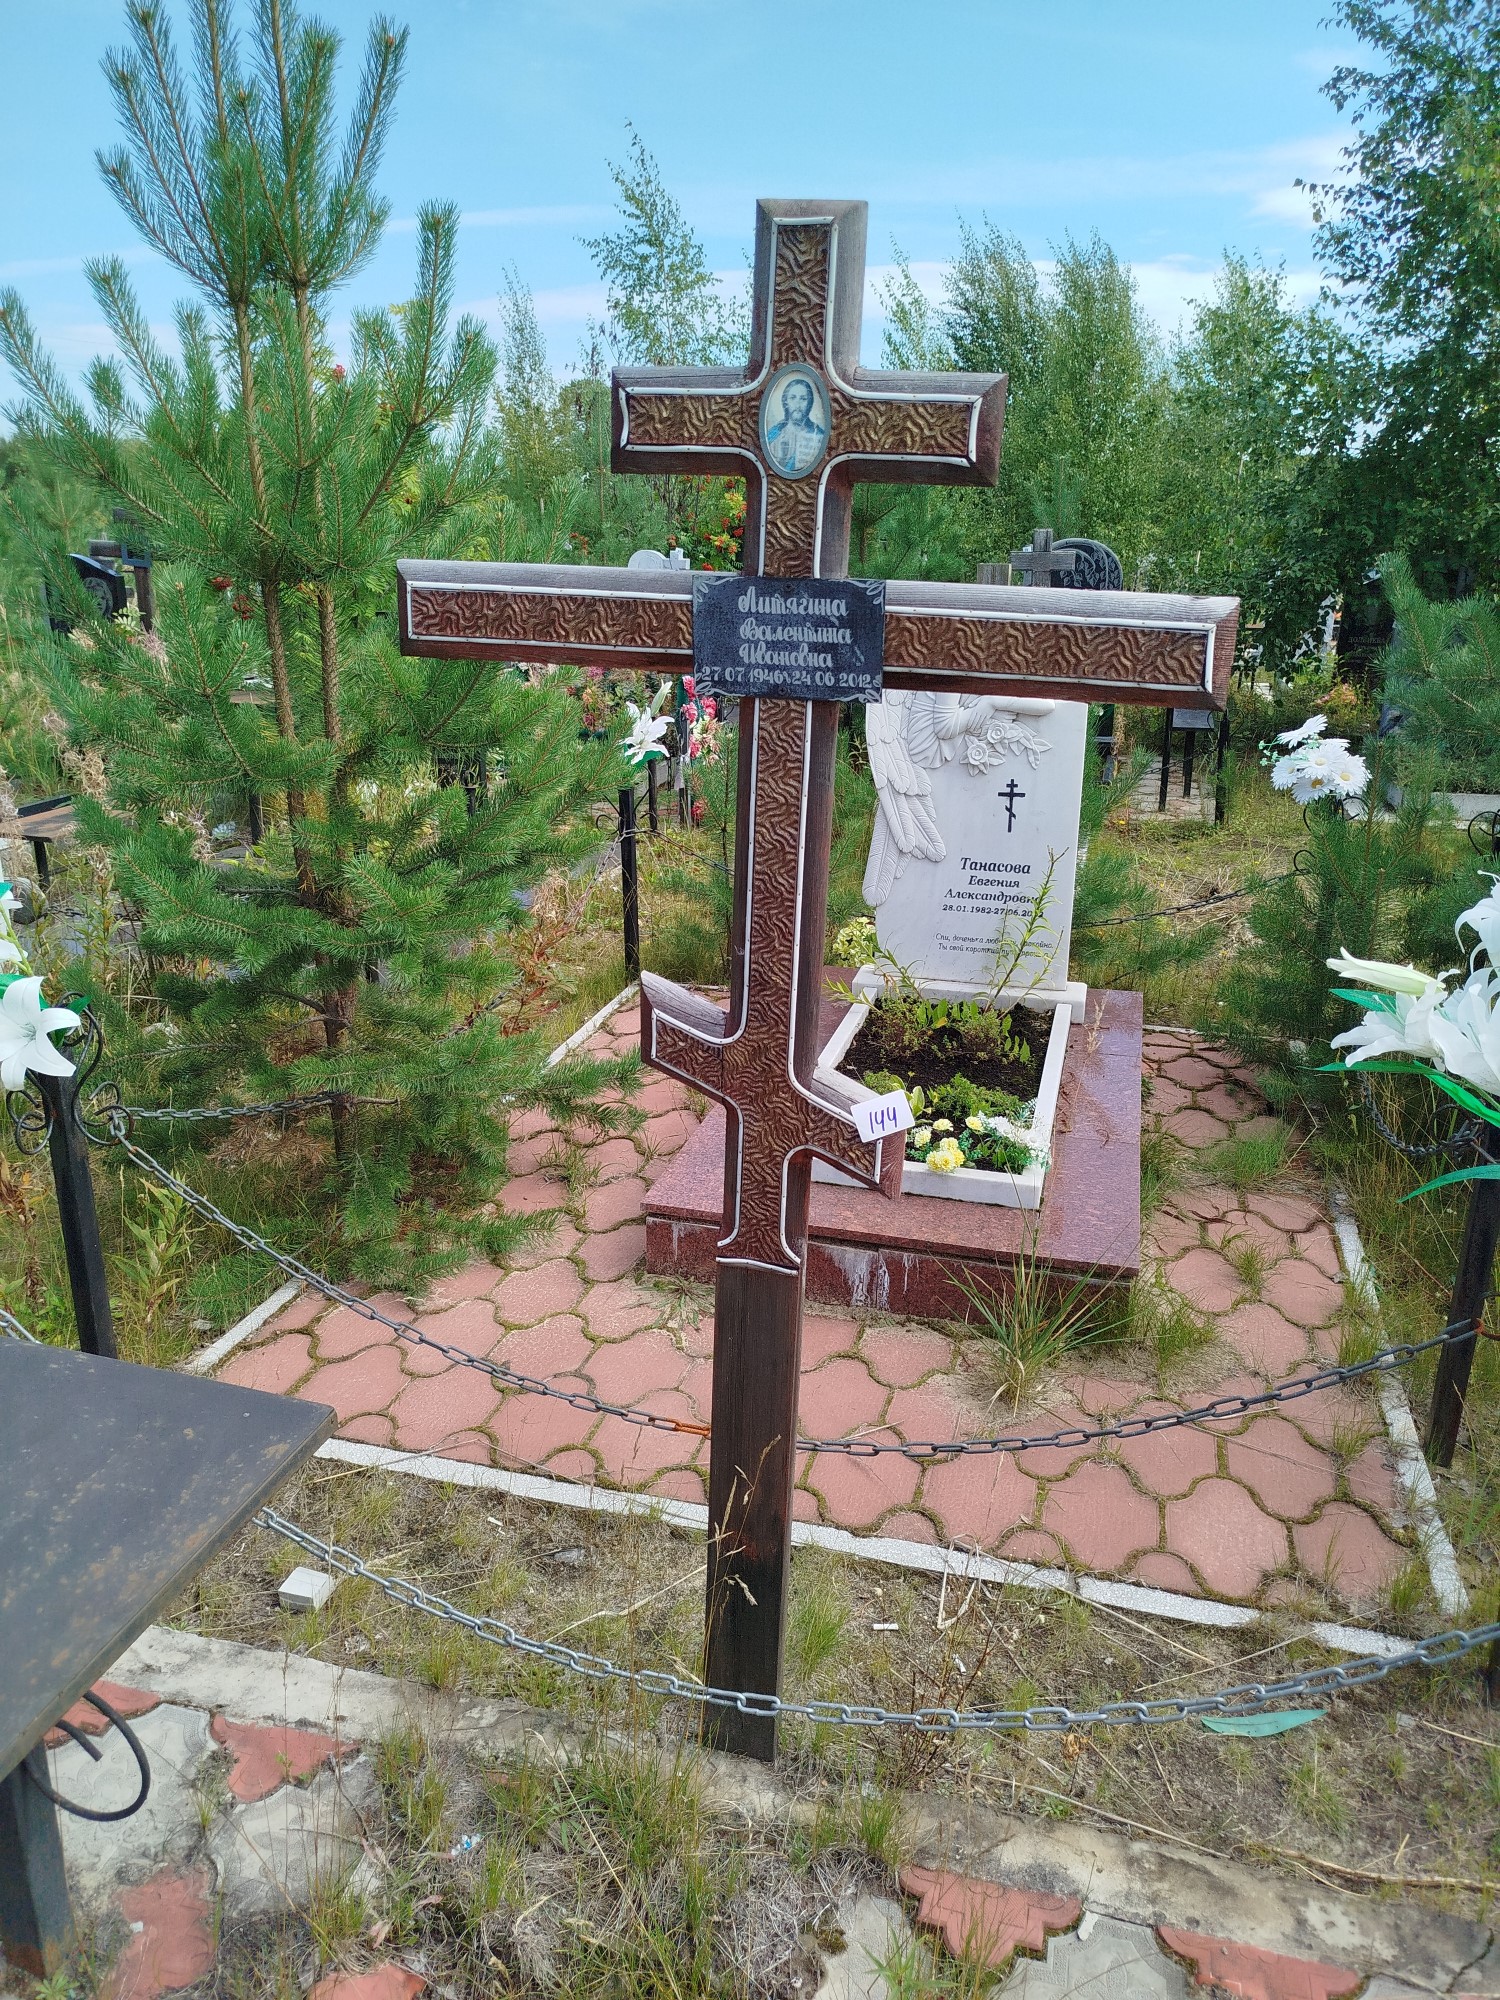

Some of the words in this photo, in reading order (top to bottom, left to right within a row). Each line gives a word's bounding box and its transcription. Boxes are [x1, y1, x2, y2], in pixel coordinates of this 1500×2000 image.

[740, 617, 853, 644] Валентина
[739, 641, 833, 668] Ивановна
[960, 857, 1031, 875] Танасова
[968, 875, 1020, 889] Евгения
[938, 942, 948, 951] Ты
[949, 944, 964, 952] свой
[869, 1106, 897, 1134] 144
